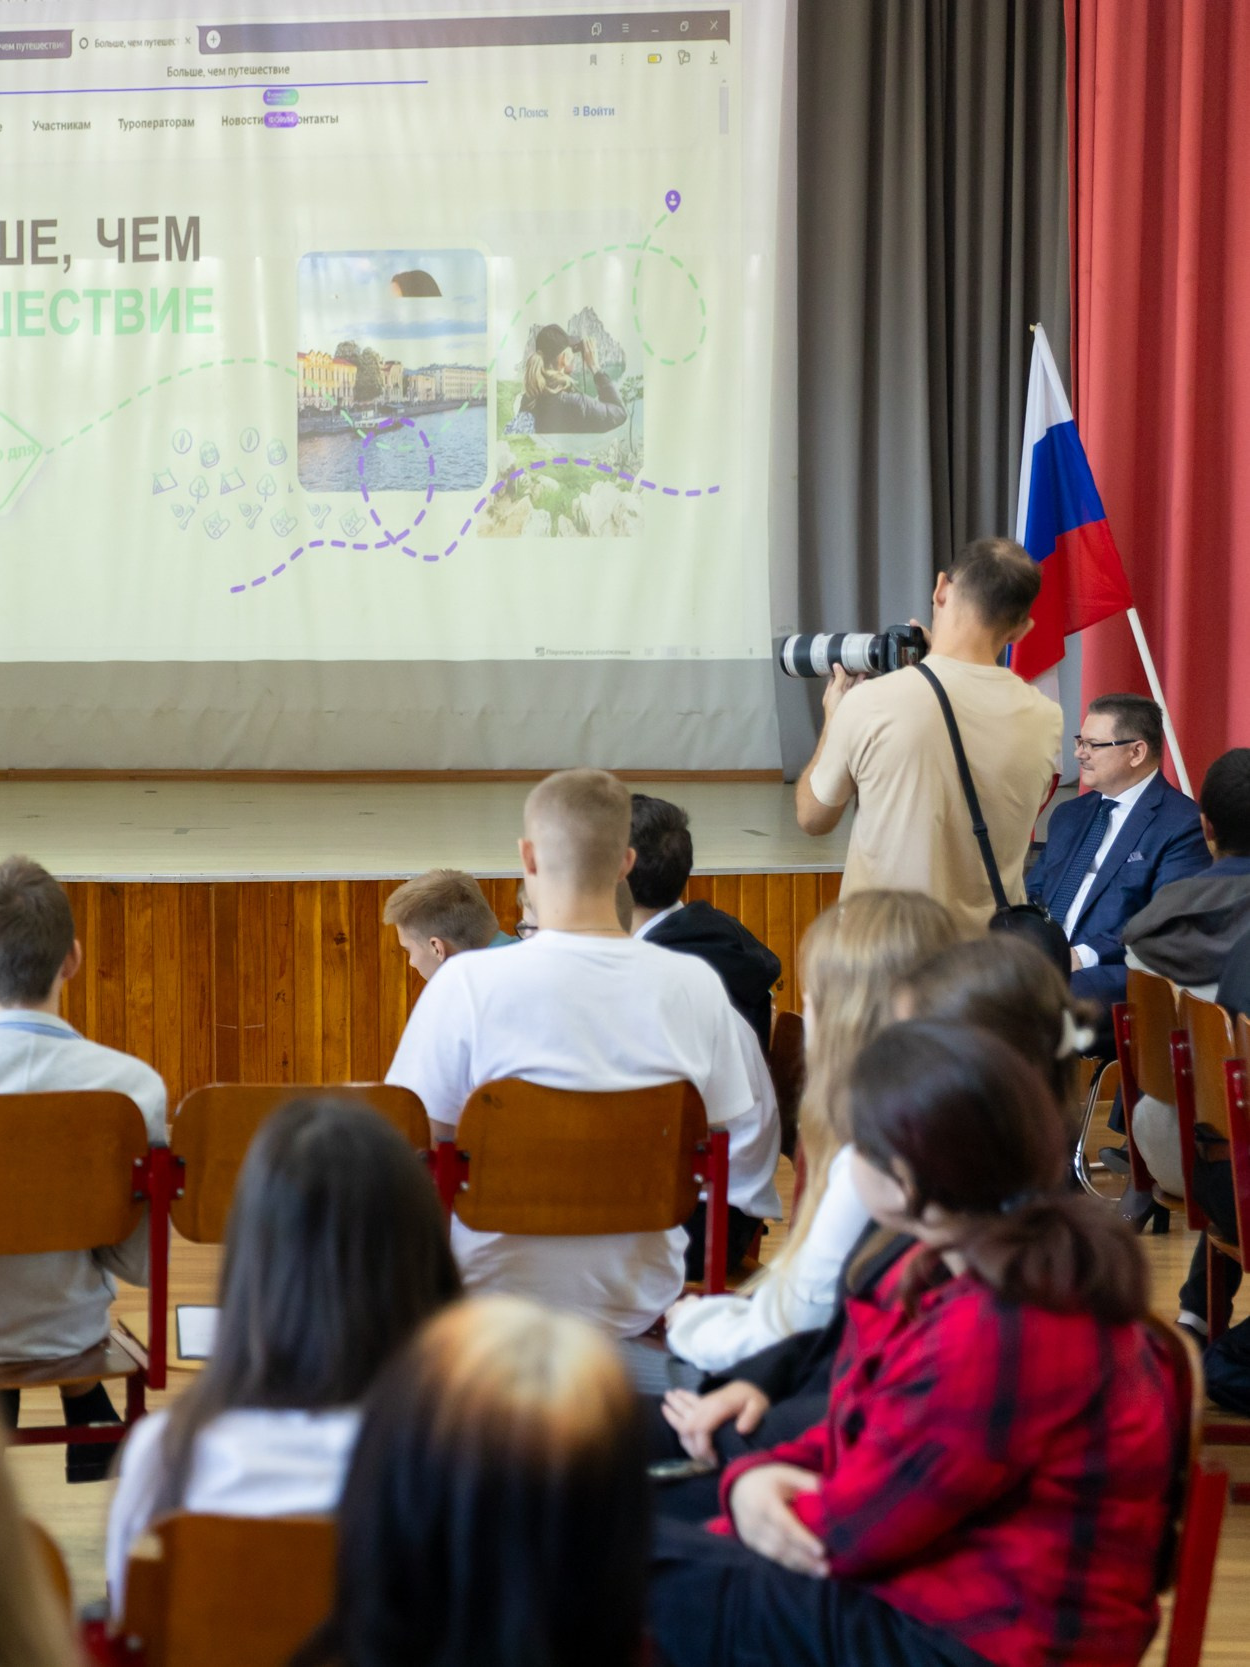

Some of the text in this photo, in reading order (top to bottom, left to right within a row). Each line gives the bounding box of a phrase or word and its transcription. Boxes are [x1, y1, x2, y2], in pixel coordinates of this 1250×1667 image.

[0, 43, 15, 51] чем
[94, 38, 126, 50] Больше,
[127, 39, 143, 47] чем
[166, 64, 291, 79] Больше, чем путешествие
[518, 107, 549, 119] Поиск
[582, 105, 615, 117] Войти
[117, 116, 195, 130] Туроператорам
[221, 114, 264, 126] Новости
[297, 112, 339, 125] онтакты
[31, 119, 92, 132] Участникам
[96, 216, 201, 263] ЧЕМ
[8, 444, 37, 462] для
